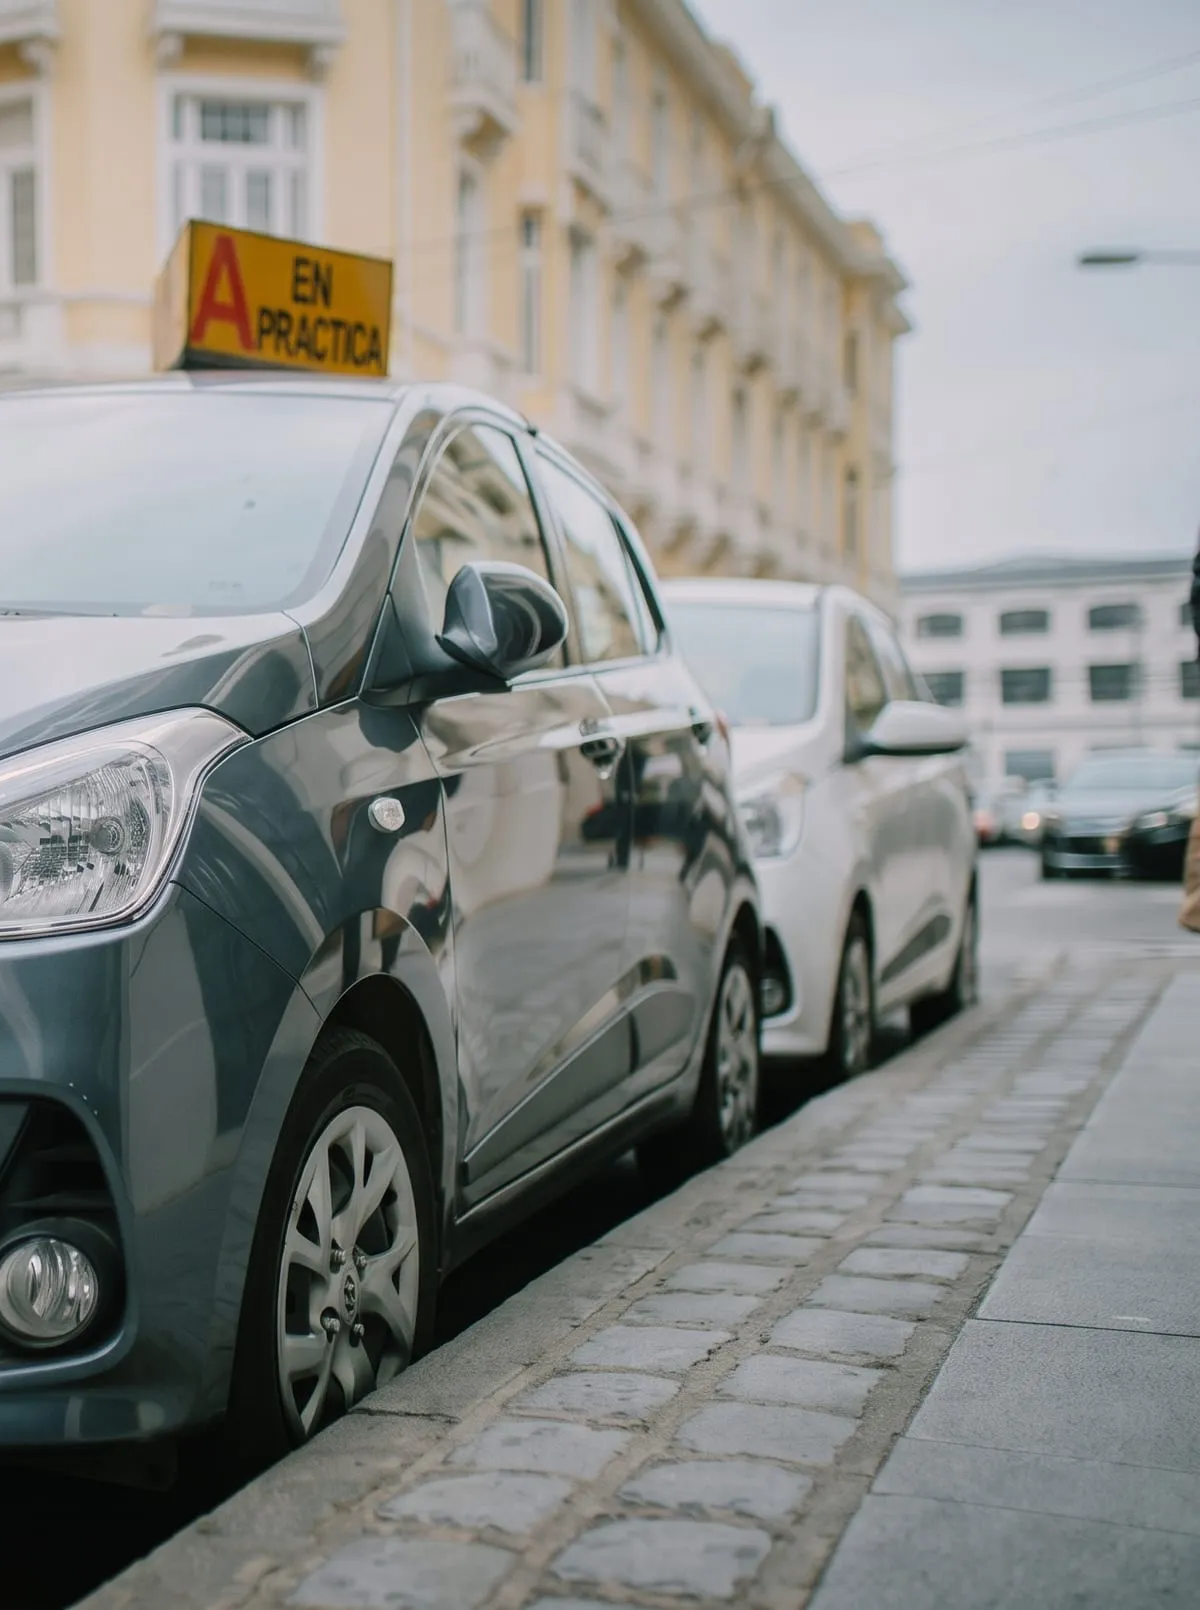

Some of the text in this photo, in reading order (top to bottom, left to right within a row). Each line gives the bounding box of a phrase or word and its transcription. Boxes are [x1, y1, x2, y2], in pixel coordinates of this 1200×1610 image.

[191, 235, 256, 351] A
[292, 257, 333, 308] EN
[257, 307, 383, 369] PRACTICA
